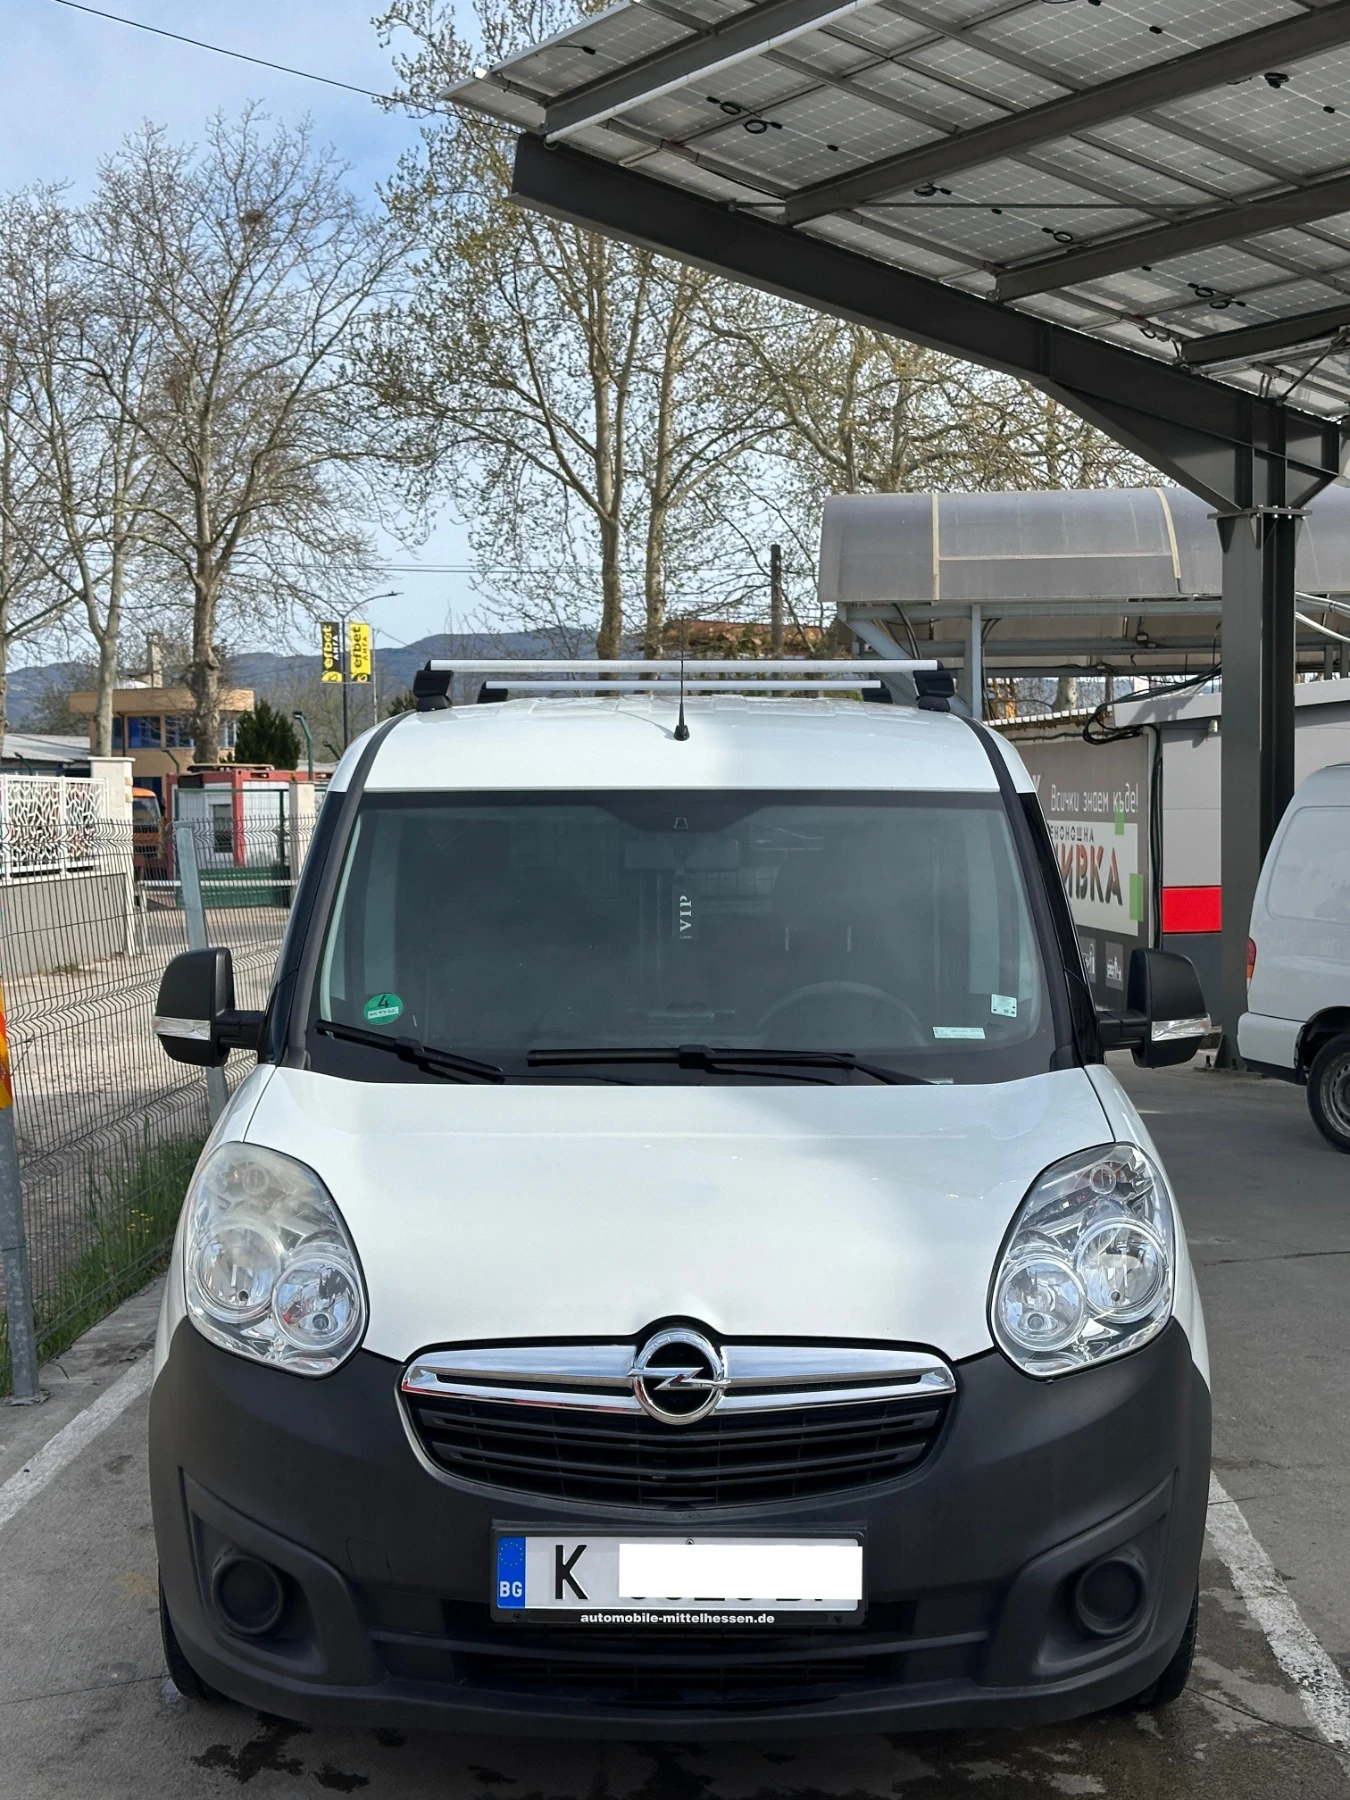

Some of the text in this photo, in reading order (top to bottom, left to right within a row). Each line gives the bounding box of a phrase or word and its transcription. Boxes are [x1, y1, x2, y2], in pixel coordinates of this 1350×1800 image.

[323, 625, 334, 669] efbet
[352, 626, 362, 668] efbet
[1051, 782, 1139, 813] Всички знаем къде!
[1050, 825, 1095, 842] ЕНОНОЩНА
[1057, 843, 1123, 906] ИВКА
[679, 895, 692, 932] VIP
[377, 994, 390, 1009] 4
[554, 1544, 588, 1600] K
[499, 1581, 523, 1598] BG
[580, 1612, 775, 1624] automobile-mittelhessen.de
